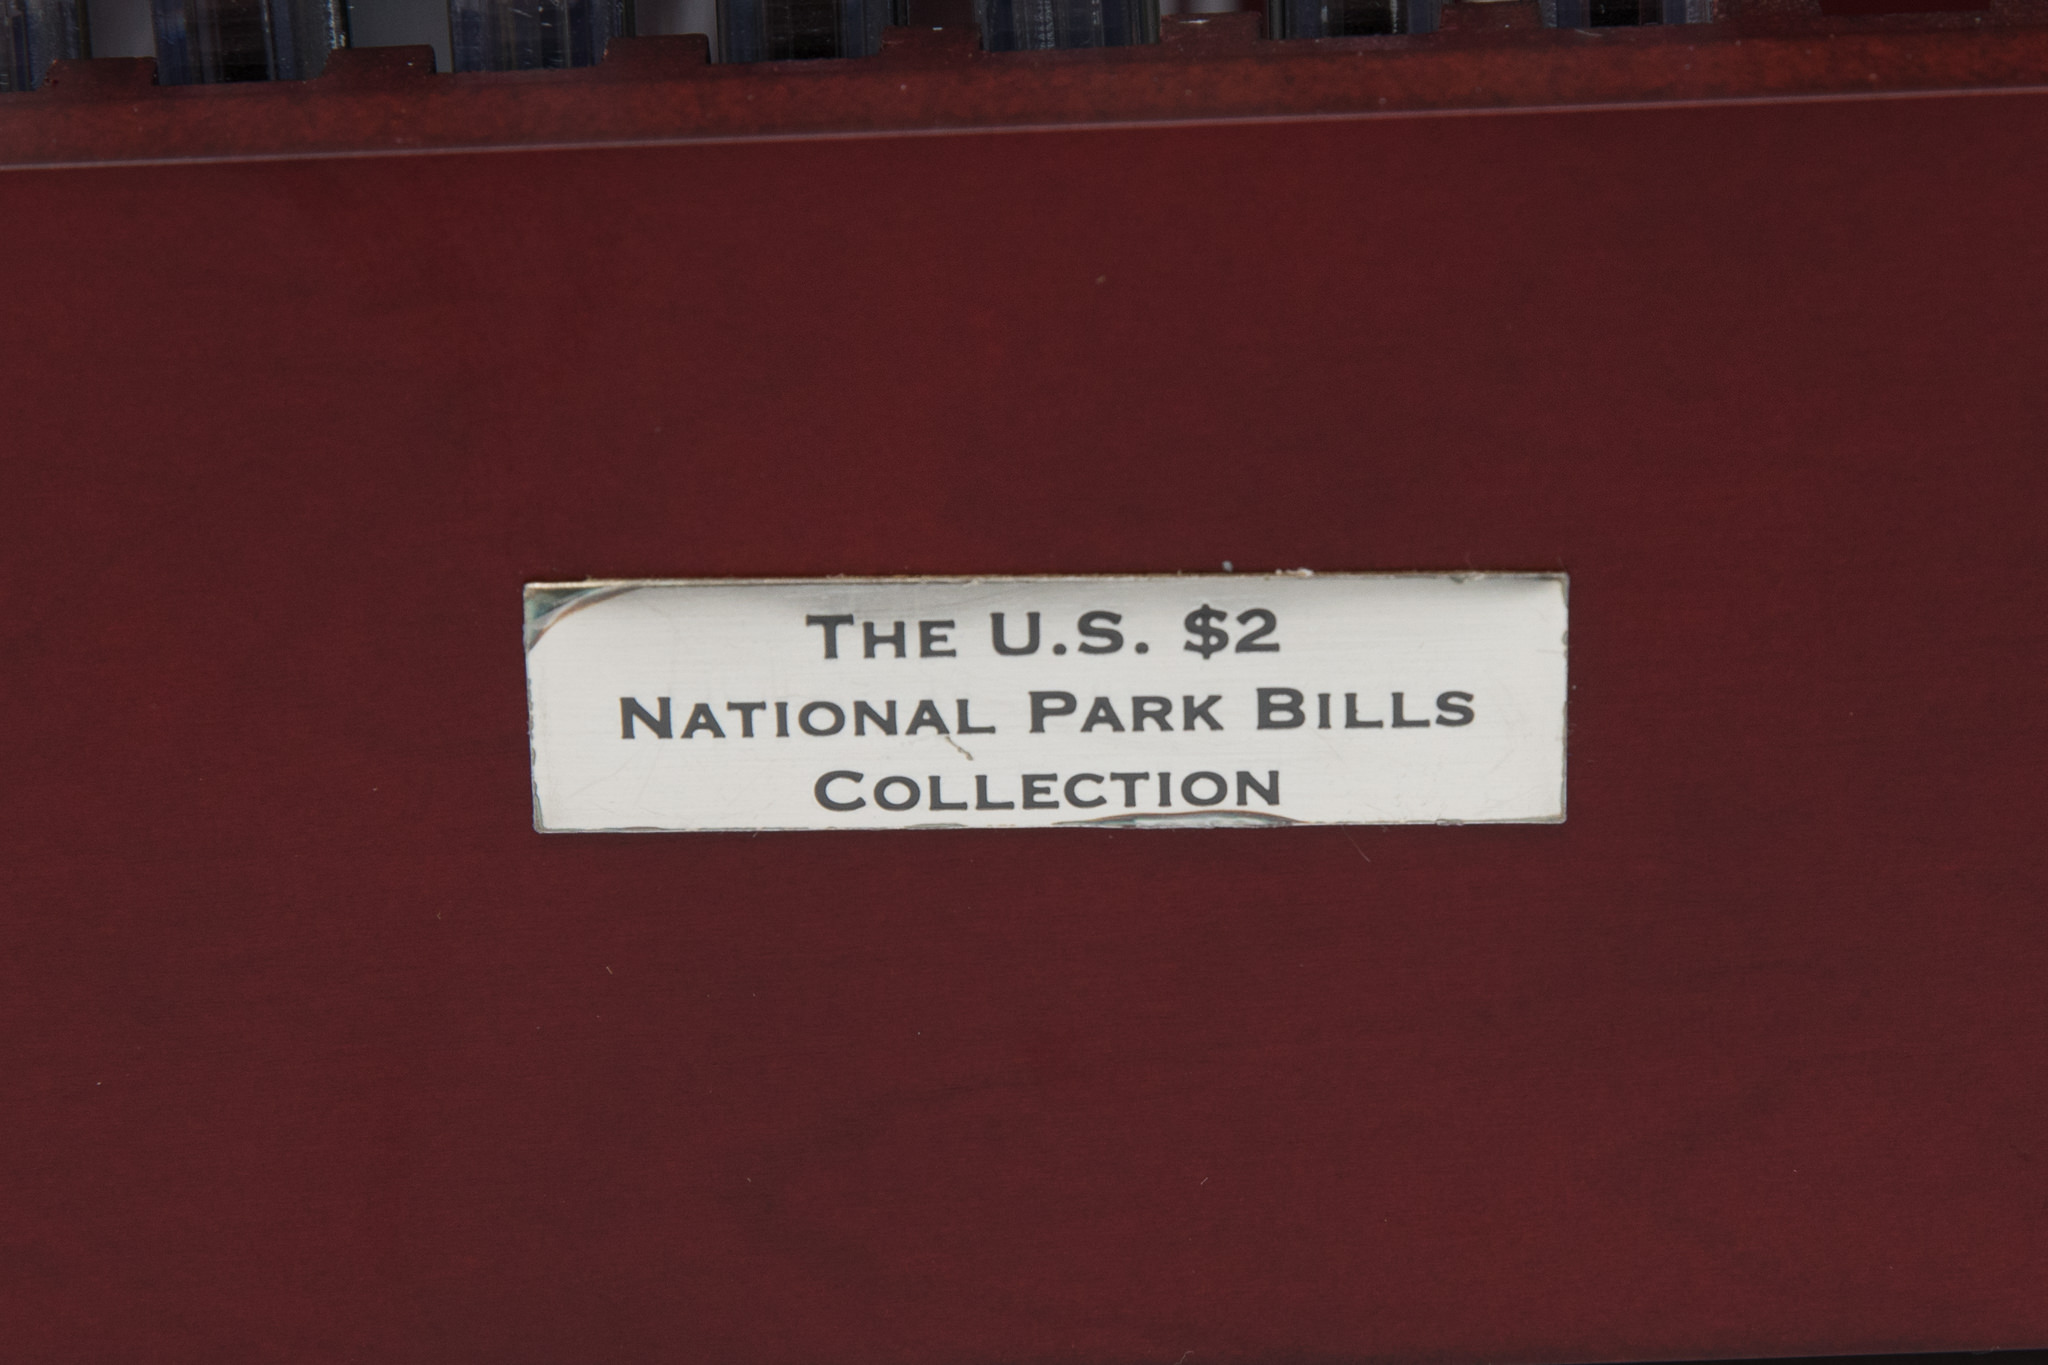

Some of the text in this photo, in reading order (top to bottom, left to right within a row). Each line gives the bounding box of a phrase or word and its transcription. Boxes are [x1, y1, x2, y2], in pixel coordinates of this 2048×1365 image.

[805, 602, 1281, 661] THE U.S. $2
[619, 686, 1476, 740] NATIONAL PARK BILLS
[813, 769, 1281, 813] COLLECTION
